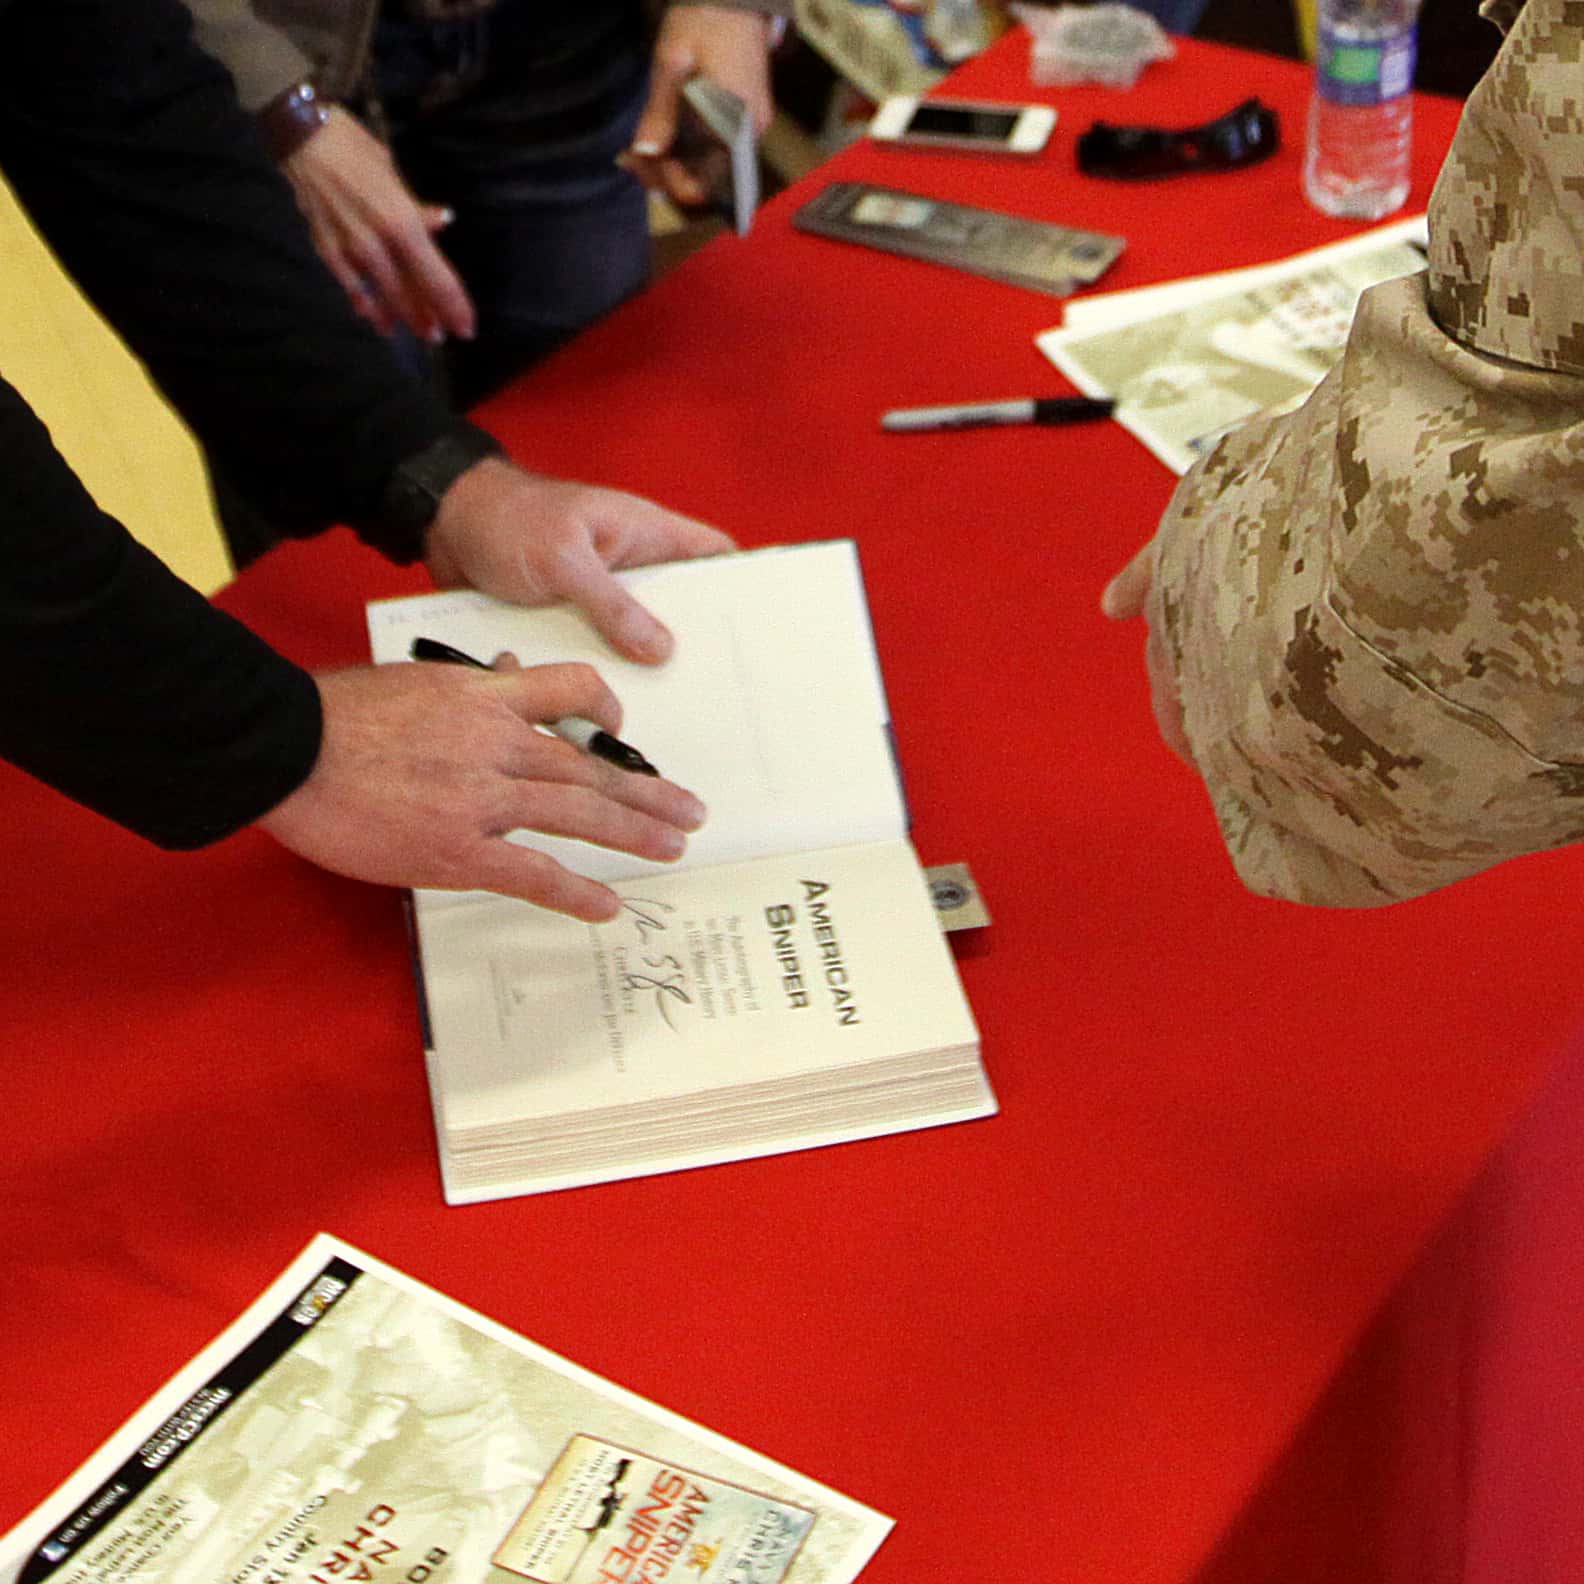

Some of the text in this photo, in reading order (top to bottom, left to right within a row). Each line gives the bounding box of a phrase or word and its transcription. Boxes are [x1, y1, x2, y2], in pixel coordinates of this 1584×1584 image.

[765, 903, 810, 1010] SNIPER
[800, 879, 861, 1027] AMERICAN
[264, 1494, 328, 1552] Country
[282, 1531, 320, 1564] Jan
